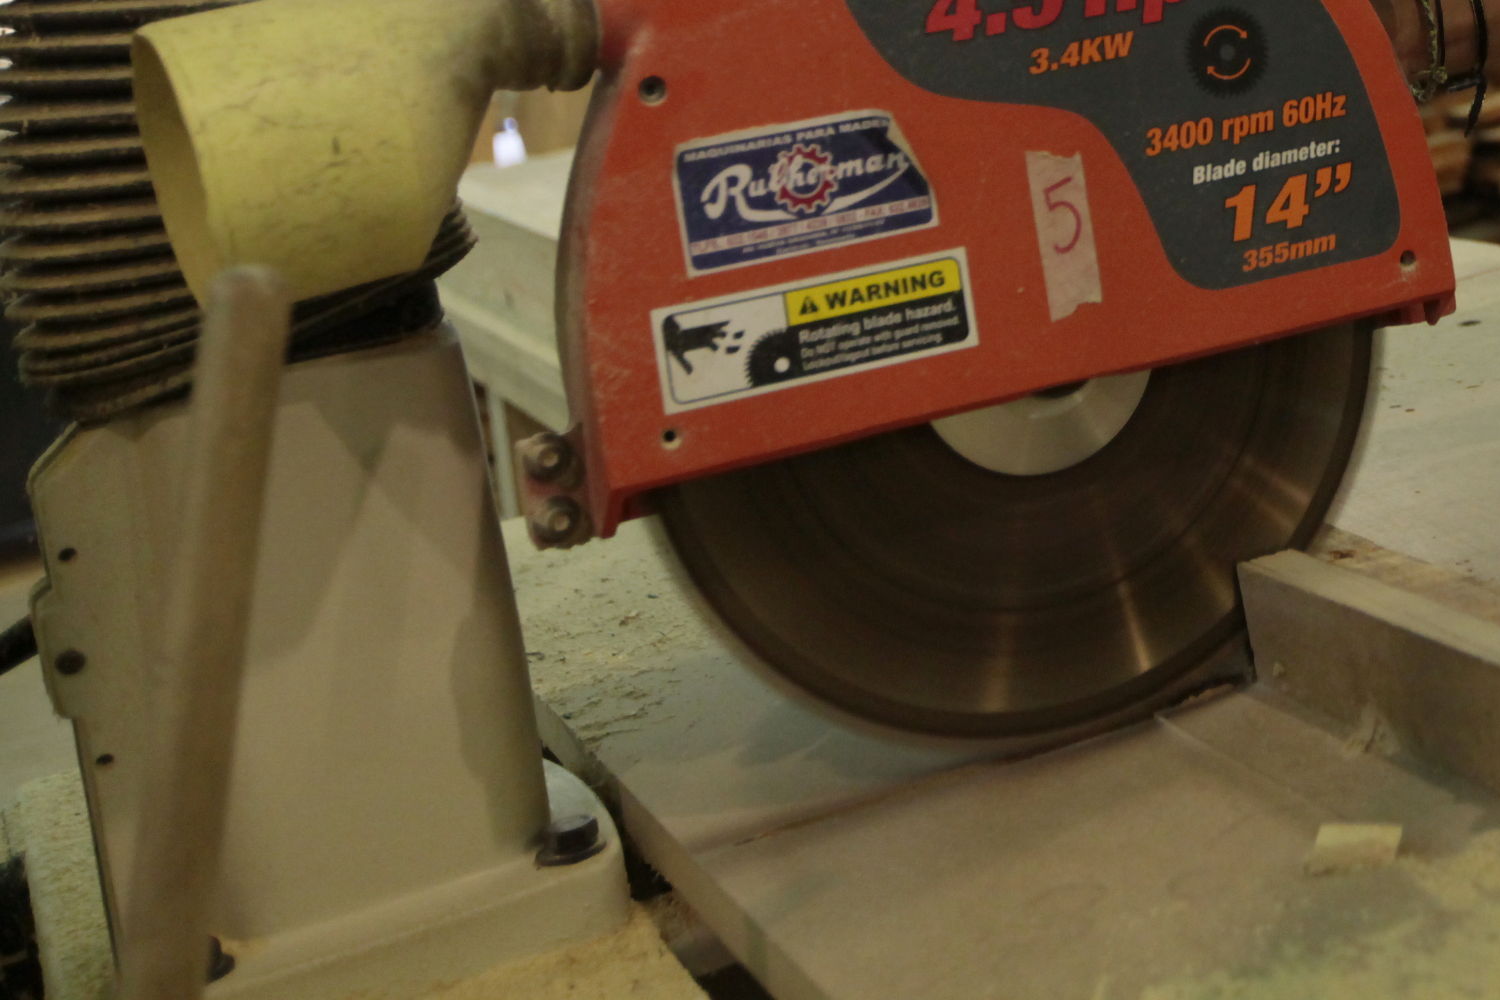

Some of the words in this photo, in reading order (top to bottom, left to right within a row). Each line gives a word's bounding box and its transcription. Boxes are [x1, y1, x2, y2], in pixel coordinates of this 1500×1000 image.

[1029, 31, 1135, 75] 3.4KW
[796, 127, 836, 142] PARA
[1145, 117, 1214, 157] 3400
[1222, 109, 1275, 145] rpm
[1282, 91, 1347, 127] 60Hz
[1193, 158, 1247, 185] Blade
[1252, 139, 1341, 172] diameter:
[1043, 175, 1083, 255] 5
[1242, 234, 1337, 272] 355mm
[824, 270, 946, 310] WARNING
[798, 321, 861, 344] Rotating
[862, 311, 903, 330] blade
